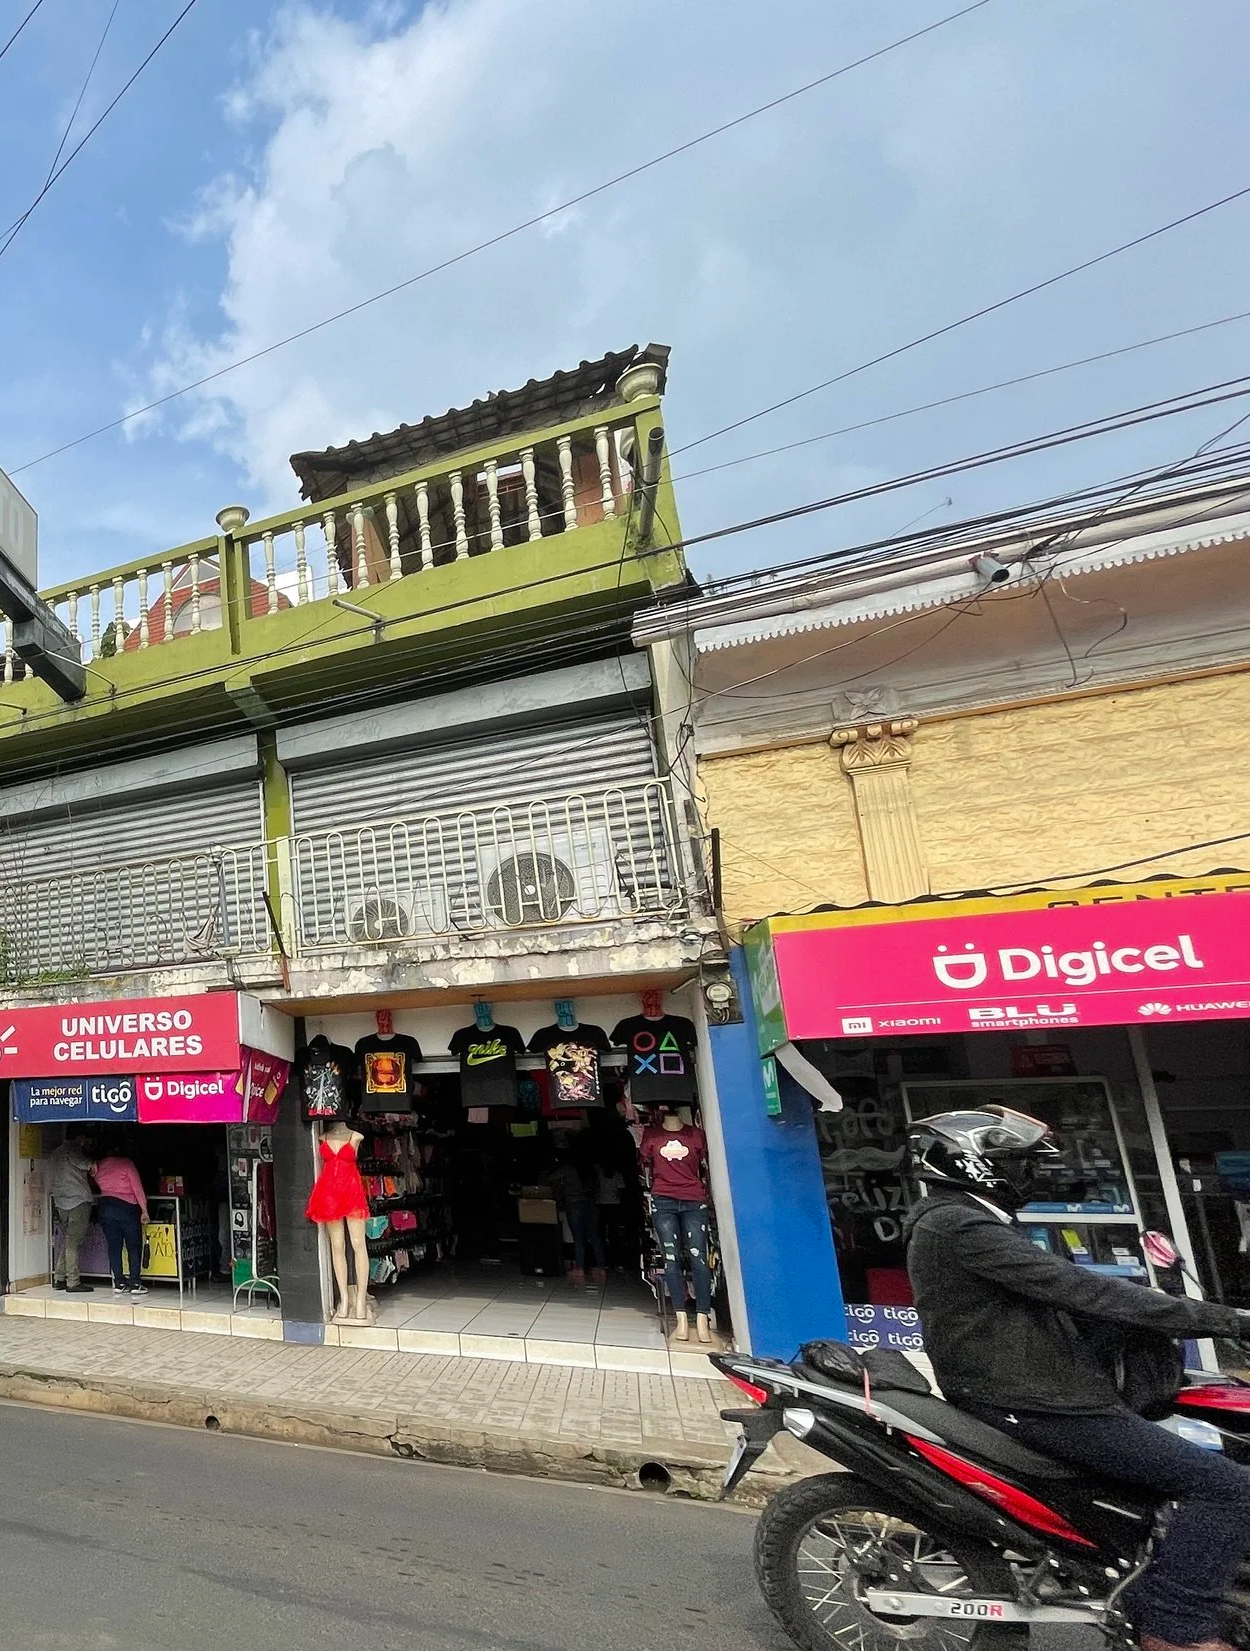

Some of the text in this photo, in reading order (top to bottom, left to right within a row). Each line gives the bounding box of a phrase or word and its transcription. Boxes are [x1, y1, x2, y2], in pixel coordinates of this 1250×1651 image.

[997, 934, 1205, 986] Digicel
[61, 1009, 192, 1037] UNIVERSO
[971, 1015, 1079, 1029] smartphones
[53, 1034, 203, 1062] CELULARES
[31, 1085, 82, 1098] La mejor red
[92, 1081, 131, 1112] tigo
[167, 1079, 224, 1099] Digicel
[30, 1096, 83, 1108] para navegar
[884, 1307, 919, 1326] tigo
[888, 1333, 923, 1351] tigo
[950, 1602, 1003, 1617] 200R
